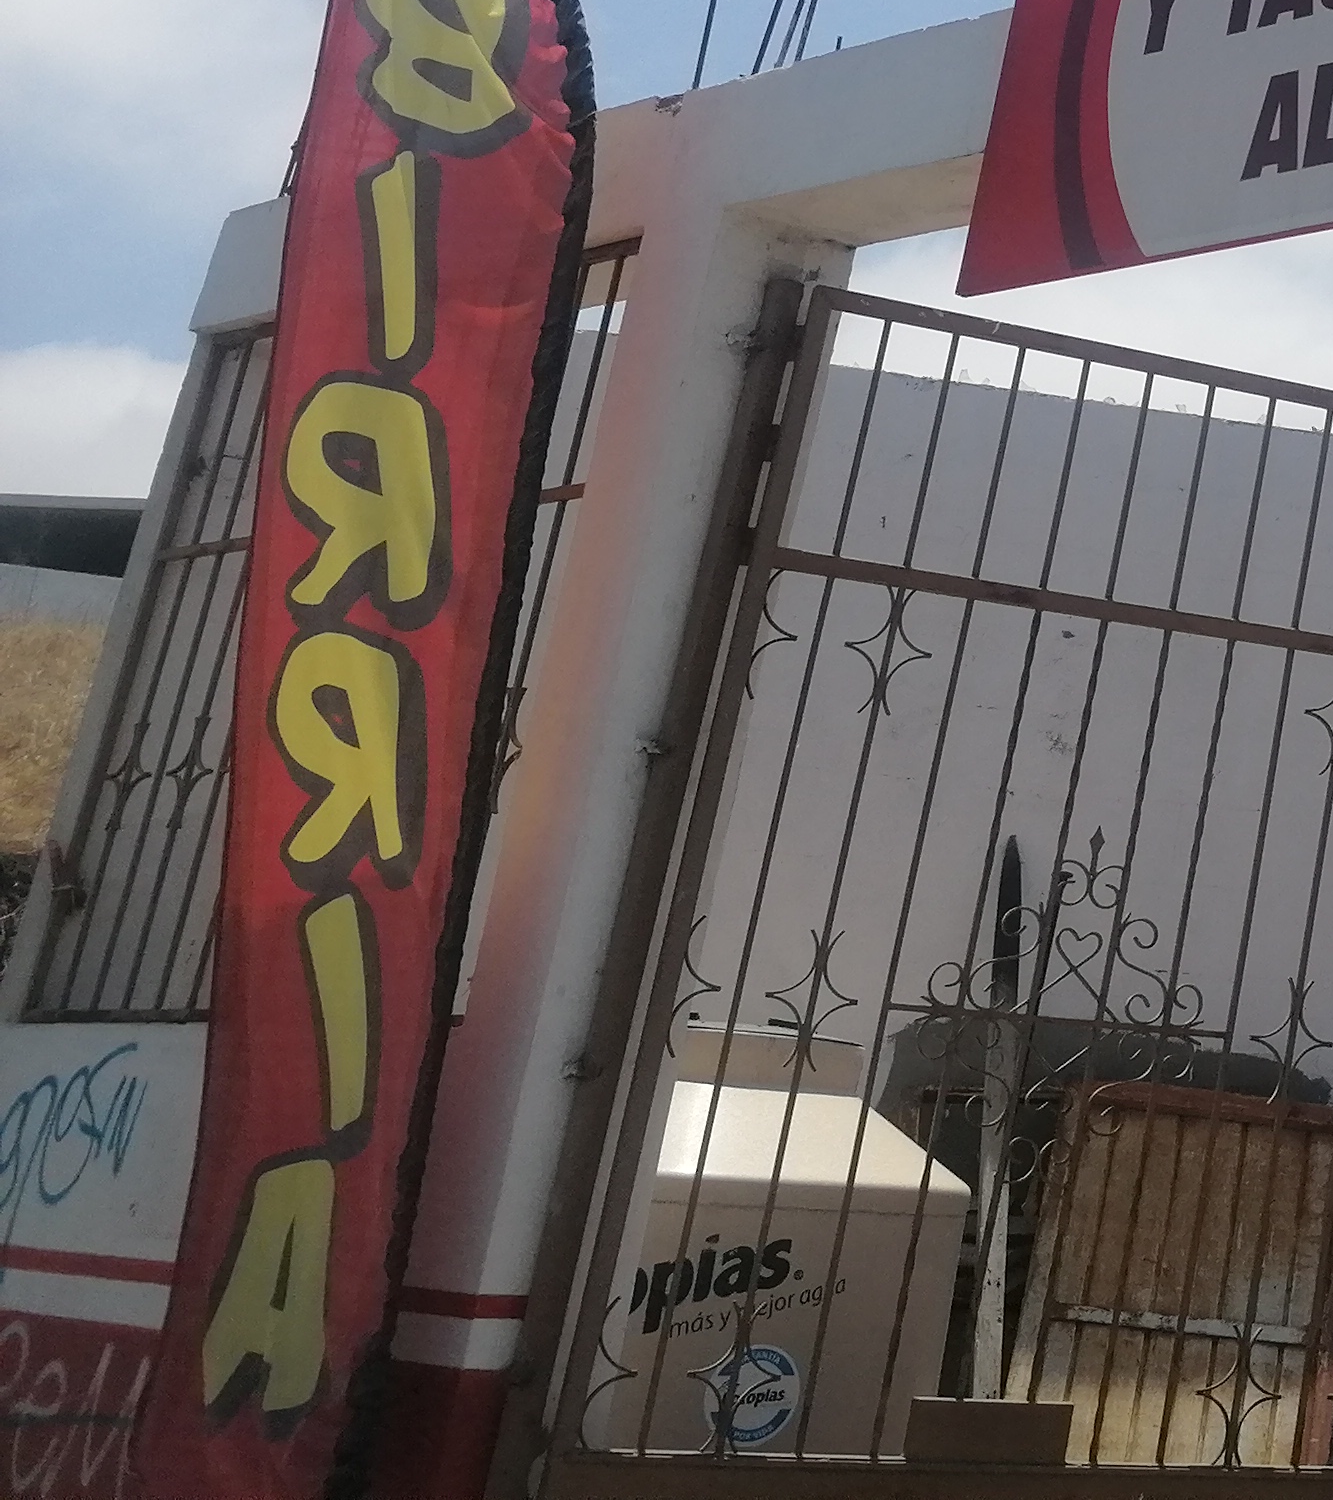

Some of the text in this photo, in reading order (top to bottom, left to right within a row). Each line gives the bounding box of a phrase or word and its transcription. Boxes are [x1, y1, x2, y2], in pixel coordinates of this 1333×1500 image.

[669, 1277, 847, 1339] más y ejor aga
